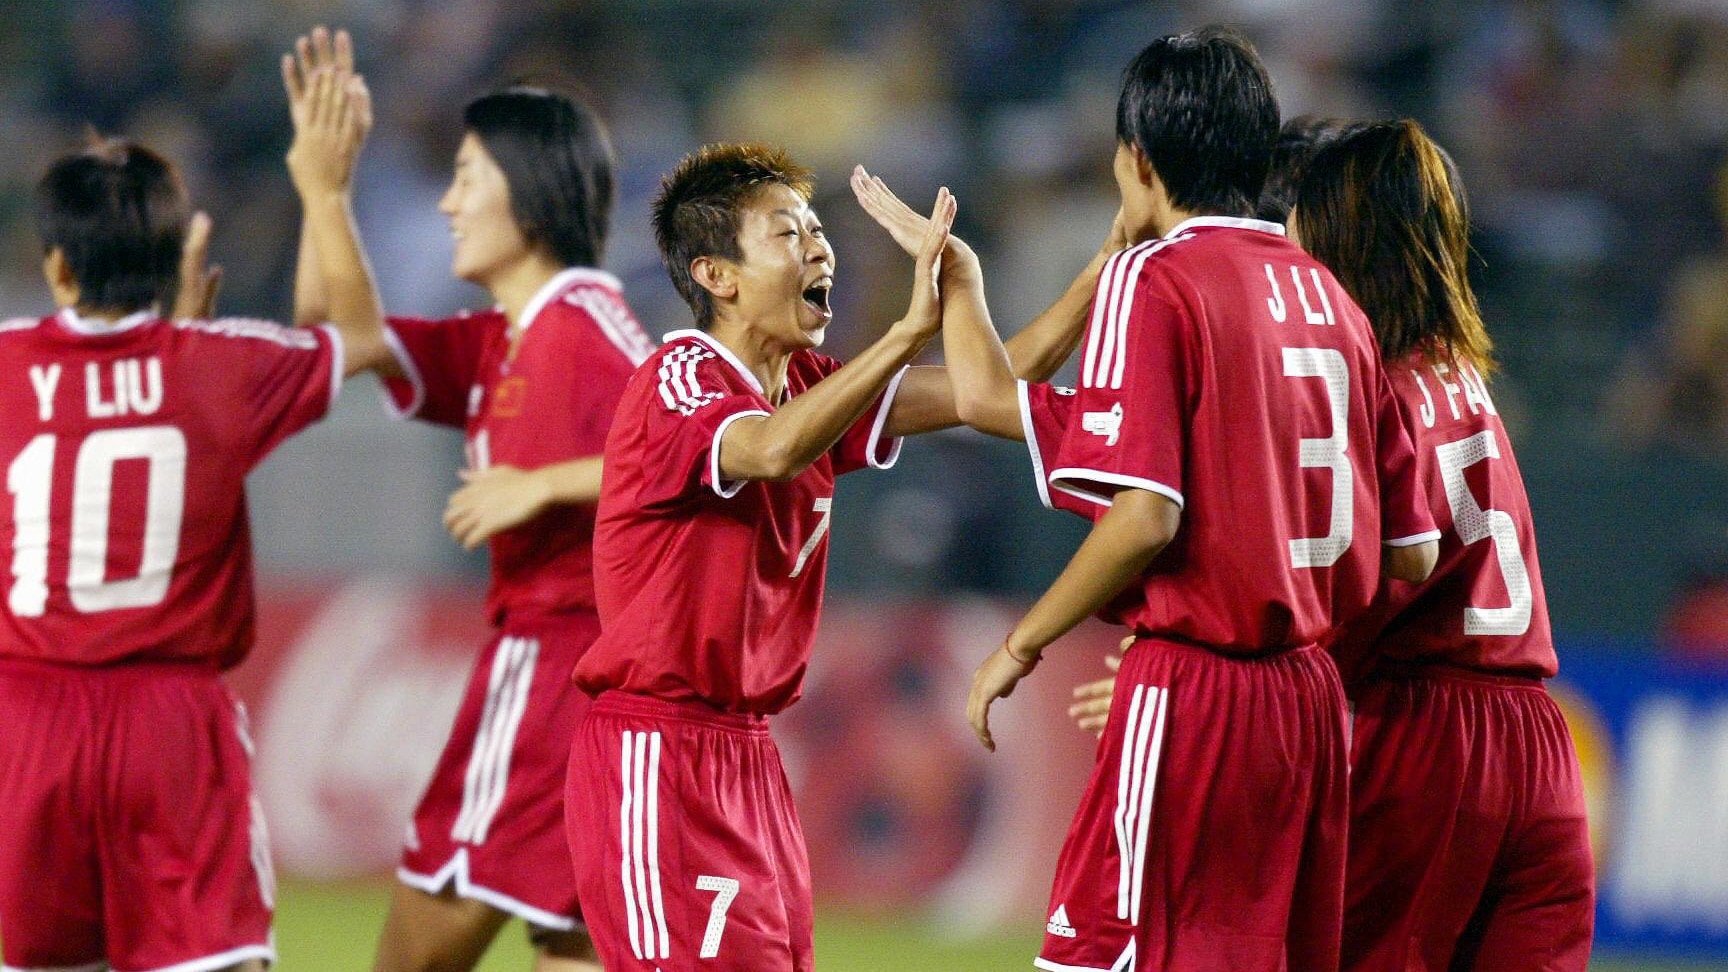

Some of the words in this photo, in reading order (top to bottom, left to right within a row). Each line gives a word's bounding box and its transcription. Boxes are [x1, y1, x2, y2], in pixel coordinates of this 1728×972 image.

[1265, 263, 1287, 324] J
[1291, 266, 1336, 326] LI
[29, 362, 62, 421] Y
[85, 356, 163, 418] LIU
[1410, 369, 1436, 428] J
[1282, 347, 1354, 569] 3
[7, 426, 187, 618] 10
[789, 497, 833, 578] 7
[1435, 430, 1533, 635] 5
[696, 876, 739, 958] 7
